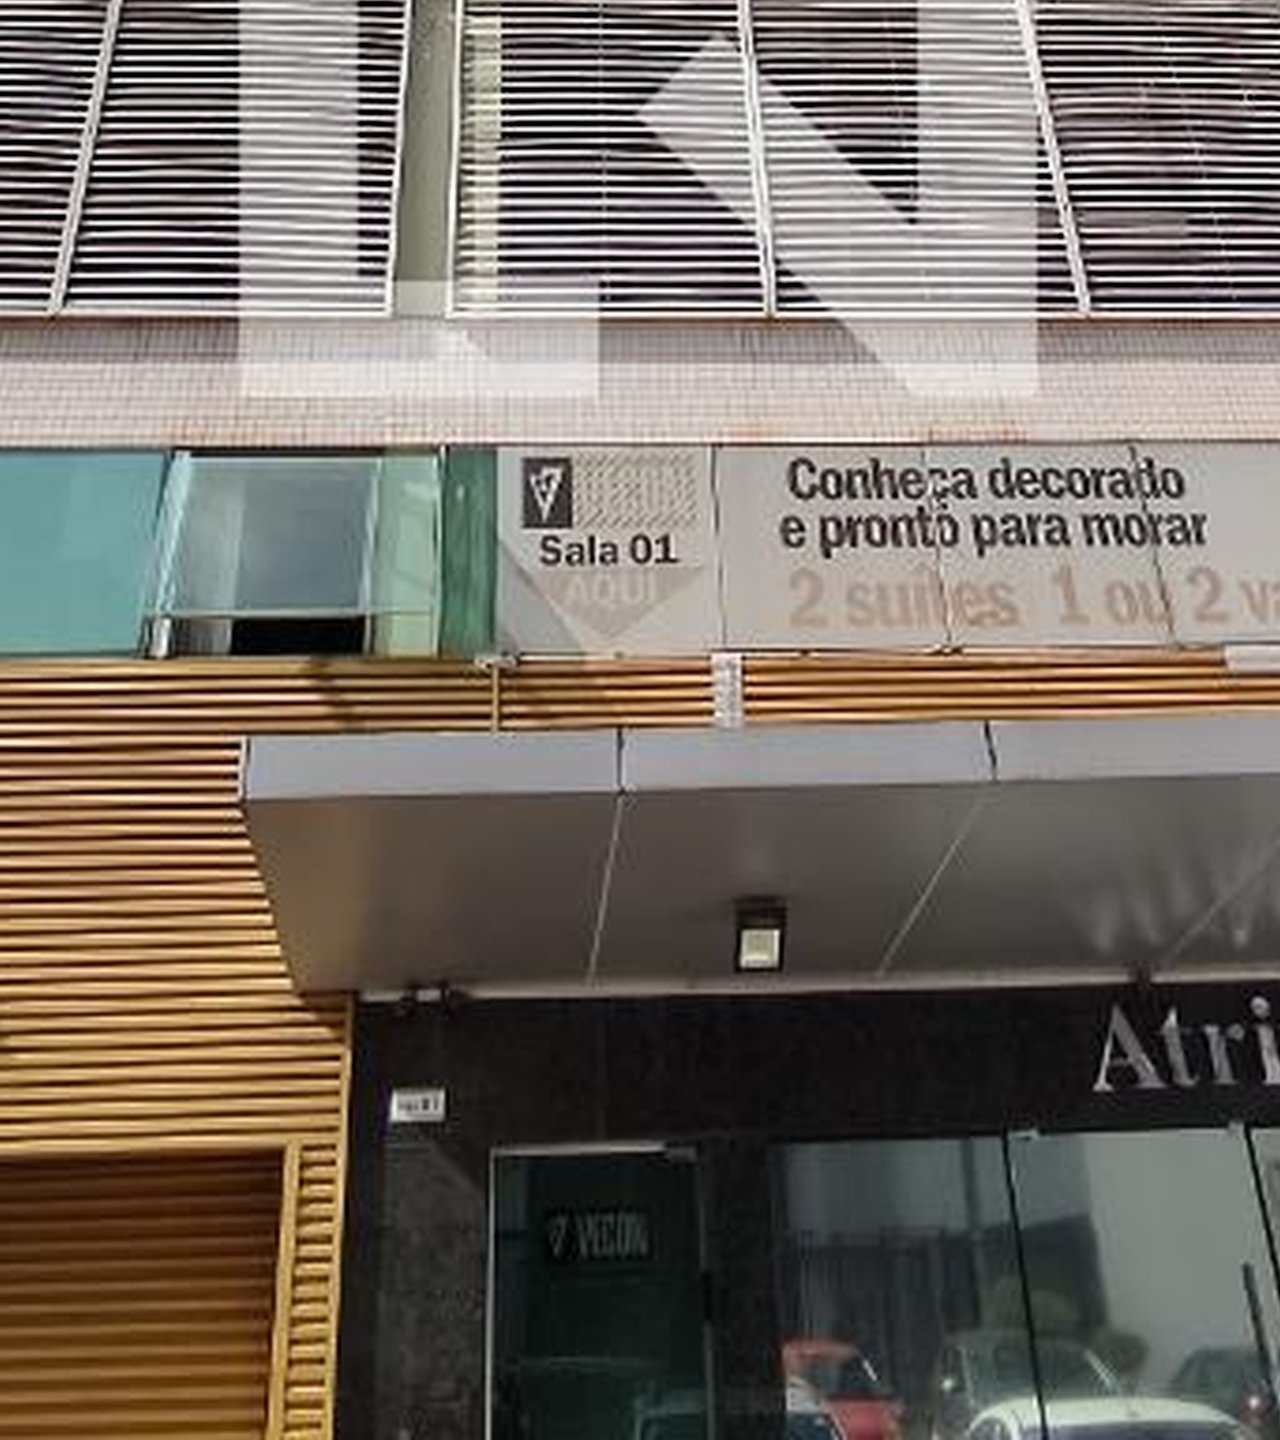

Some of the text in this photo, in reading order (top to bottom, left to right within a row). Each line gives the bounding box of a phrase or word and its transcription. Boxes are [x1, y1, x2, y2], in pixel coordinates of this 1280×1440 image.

[789, 456, 1186, 504] Conheça decorado
[539, 532, 679, 566] Sala 01
[780, 504, 1208, 560] e pronto para morar
[789, 566, 828, 628] 2
[1054, 564, 1090, 625] 1
[1105, 578, 1176, 626] ou
[1186, 566, 1229, 623] 2
